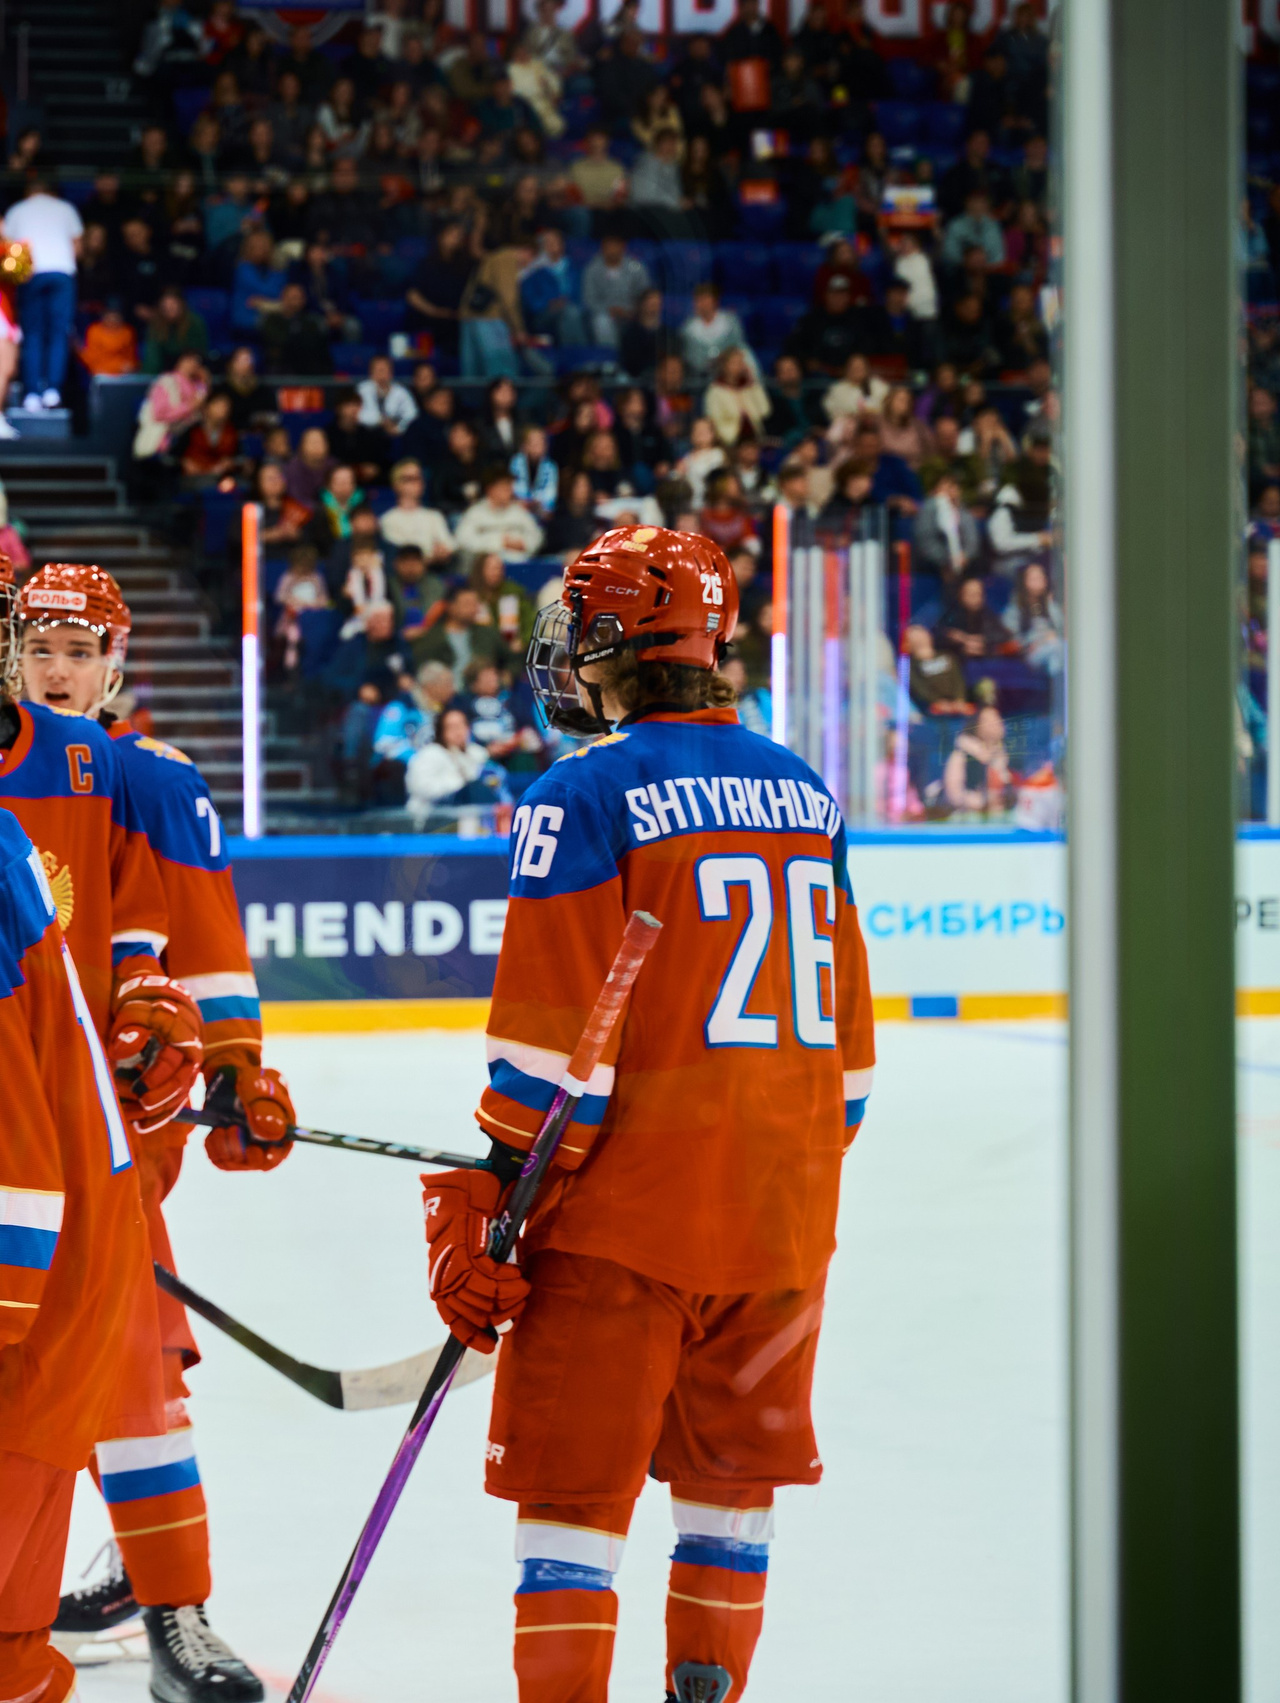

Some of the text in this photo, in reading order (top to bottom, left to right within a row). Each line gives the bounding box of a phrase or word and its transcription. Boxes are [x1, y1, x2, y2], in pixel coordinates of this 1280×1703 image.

[30, 591, 84, 607] РОЛЬФ
[604, 584, 641, 598] CCM
[699, 572, 724, 606] 26
[65, 744, 94, 794] C
[866, 903, 1066, 938] СИБИРЬ
[694, 853, 836, 1050] 26
